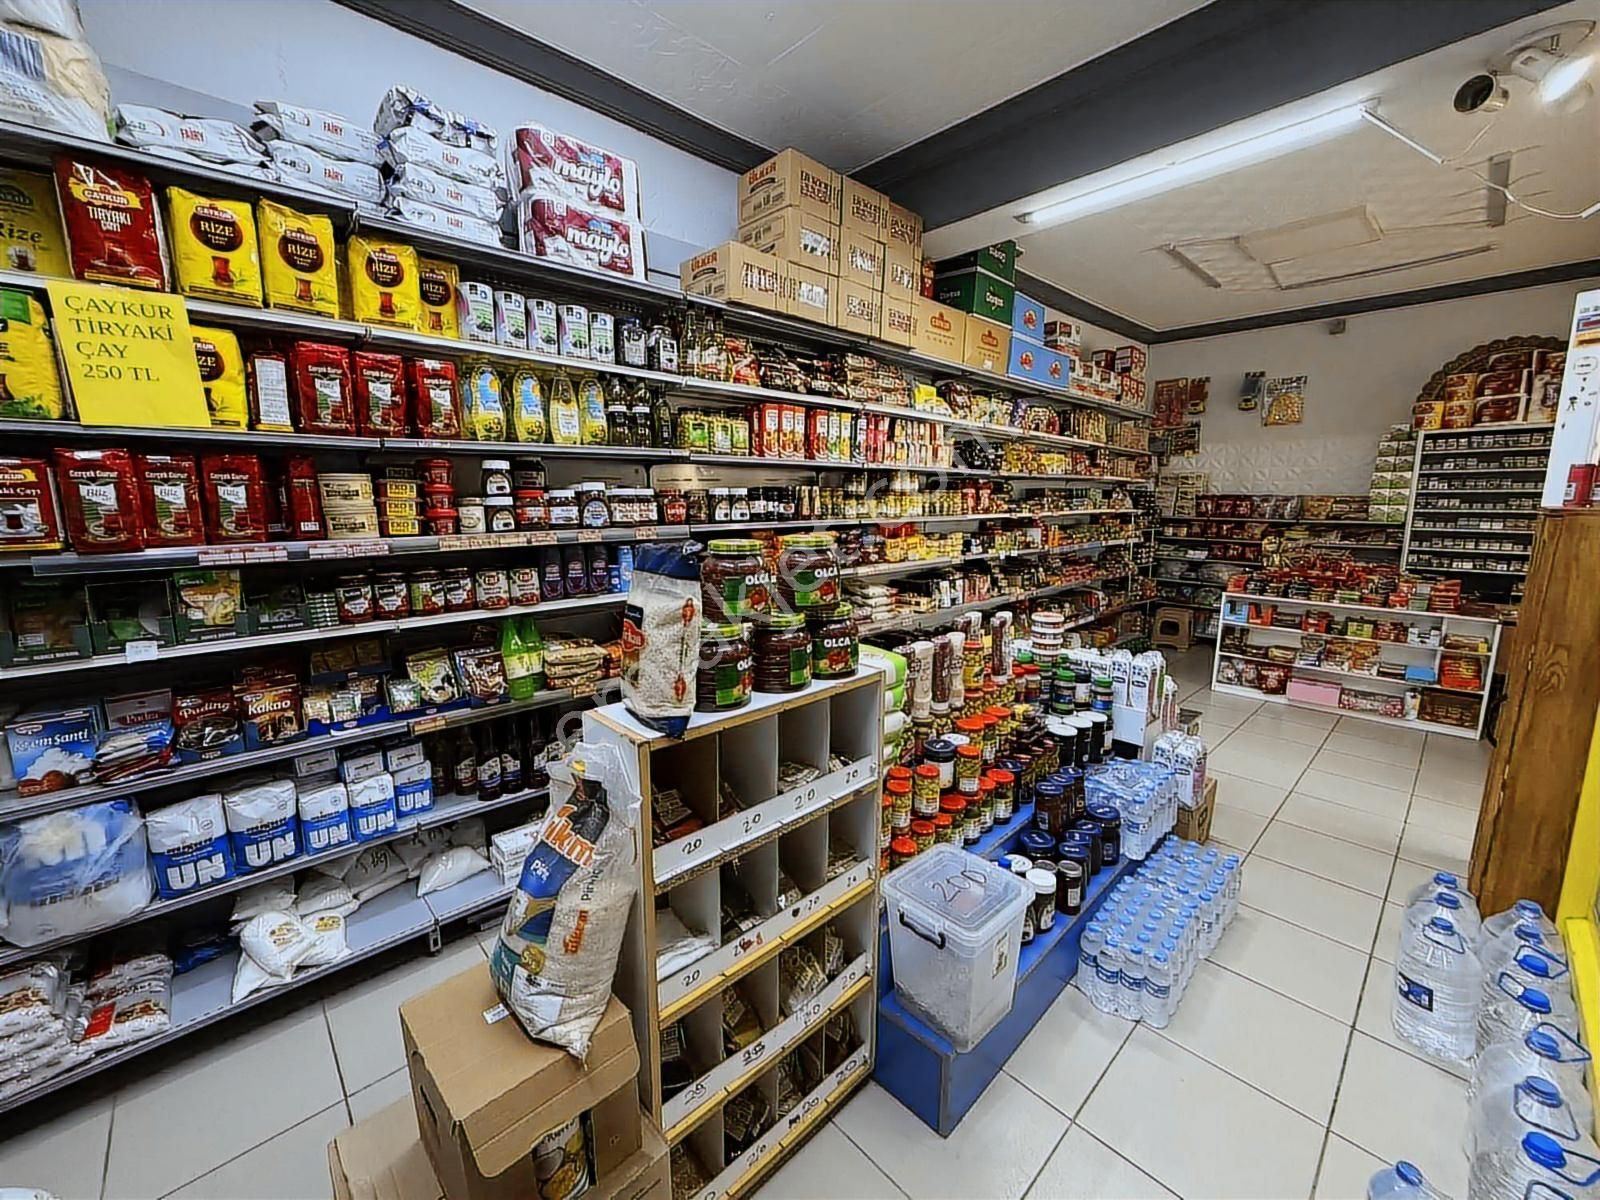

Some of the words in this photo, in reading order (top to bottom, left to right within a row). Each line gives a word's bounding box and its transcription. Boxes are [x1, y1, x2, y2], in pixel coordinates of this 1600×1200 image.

[567, 226, 630, 264] maylo
[64, 294, 175, 320] ÇAYKUR
[69, 316, 174, 341] TİRYAKİ
[76, 341, 128, 360] ÇAY
[81, 363, 123, 380] 250
[179, 702, 231, 719] Puding
[248, 699, 291, 715] Kakao
[398, 789, 431, 812] UN
[358, 809, 395, 835] UN
[743, 813, 761, 833] 20
[309, 822, 348, 849] UN
[682, 838, 702, 855] 20
[244, 831, 296, 868] UN
[166, 852, 226, 891] UN
[681, 969, 700, 987] 20
